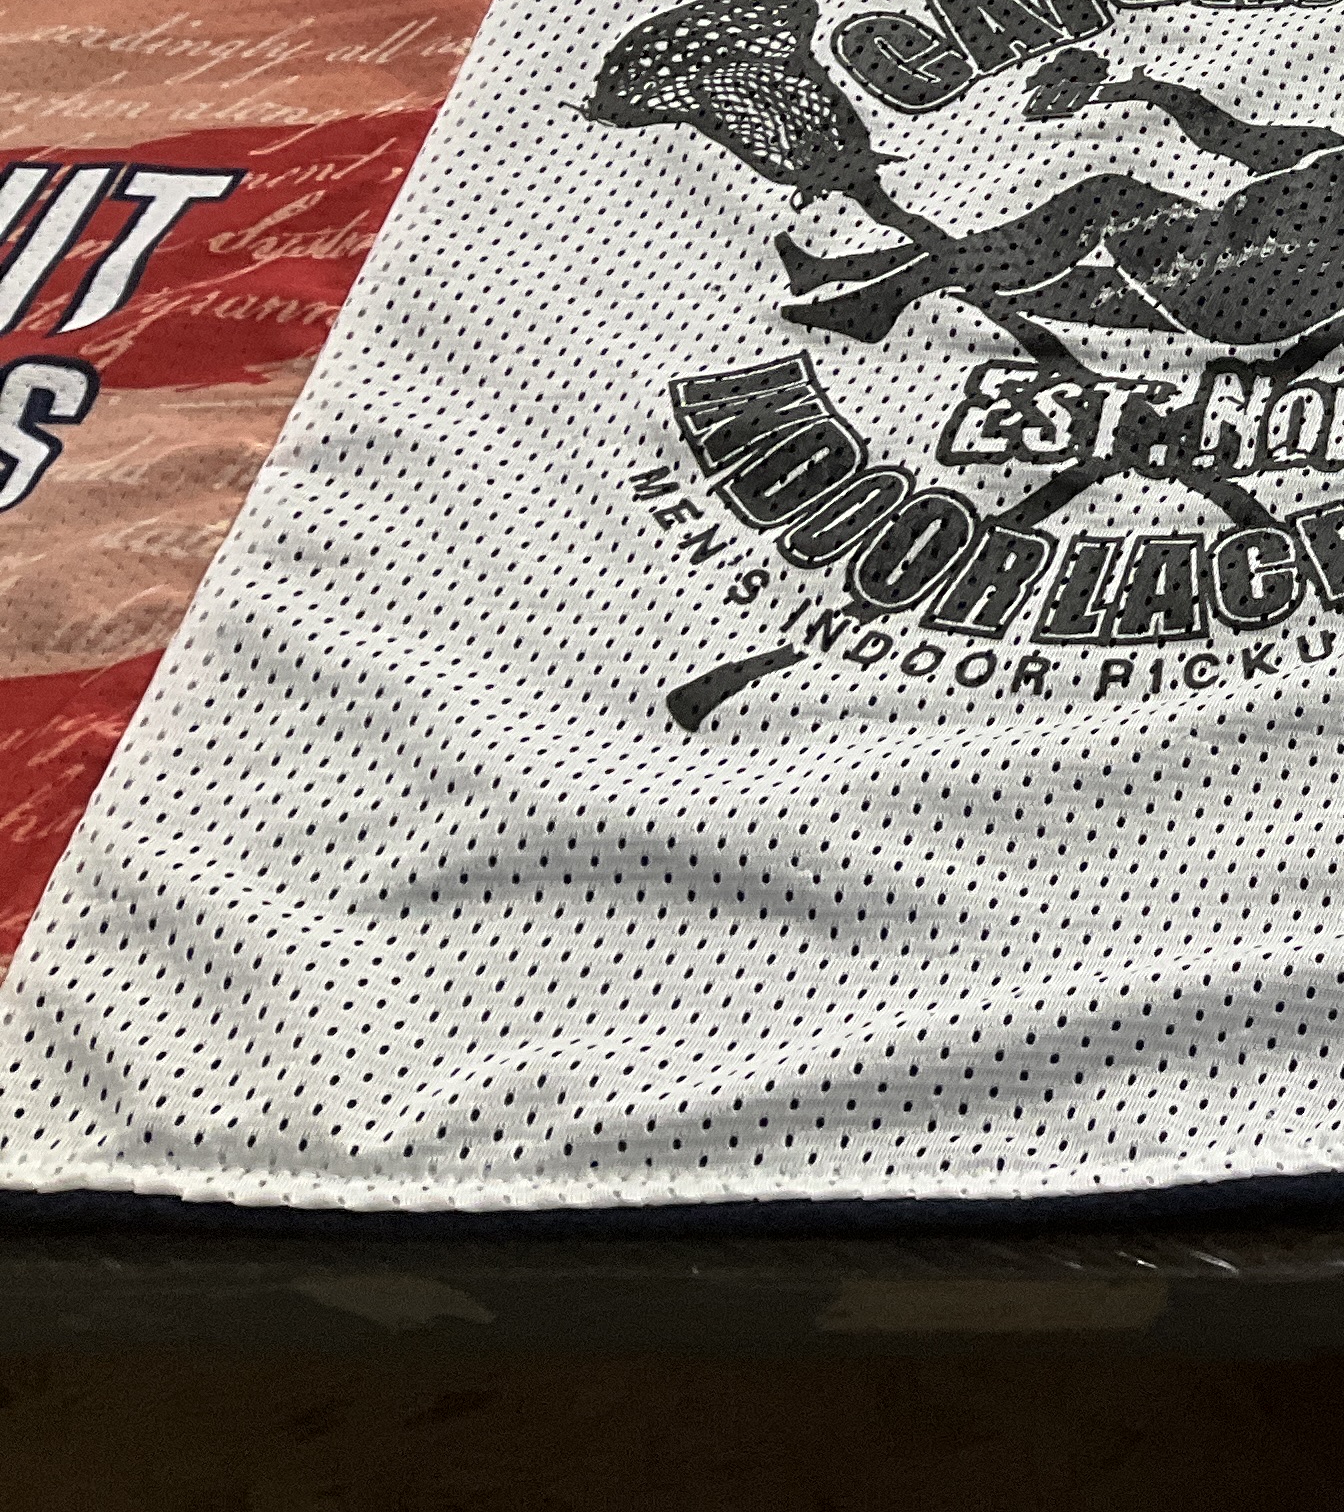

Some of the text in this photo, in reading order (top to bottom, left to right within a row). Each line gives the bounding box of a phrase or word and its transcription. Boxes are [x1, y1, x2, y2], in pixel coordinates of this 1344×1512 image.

[629, 465, 772, 608] MEN'S
[779, 598, 1053, 696] INDOOR
[668, 348, 1058, 641] INDOOR
